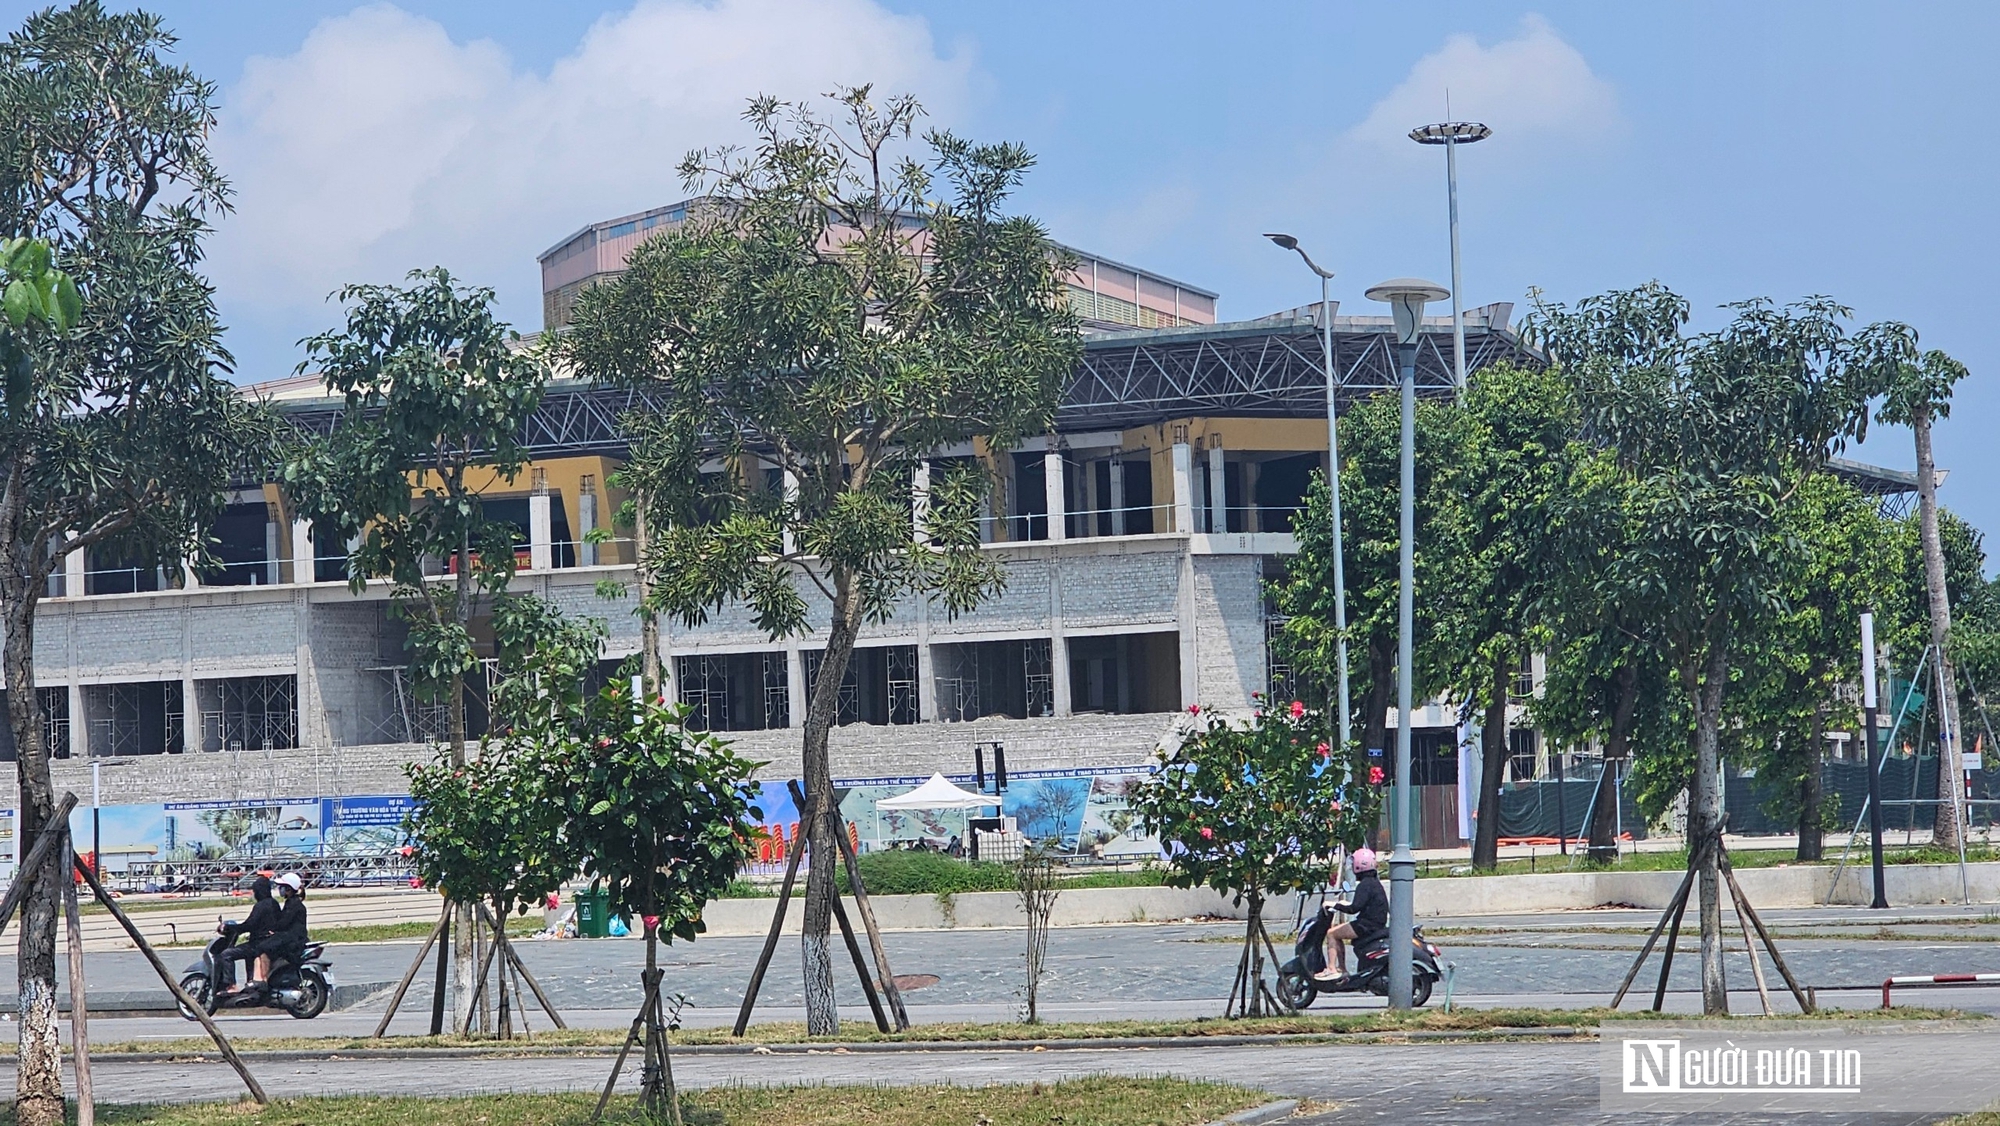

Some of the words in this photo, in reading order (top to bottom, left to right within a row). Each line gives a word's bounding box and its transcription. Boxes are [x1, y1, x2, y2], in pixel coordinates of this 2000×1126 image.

[844, 778, 865, 786] TRƯỜNG
[901, 777, 916, 785] THAO
[962, 773, 972, 782] HUẾ
[1019, 771, 1040, 779] TRƯỜNG
